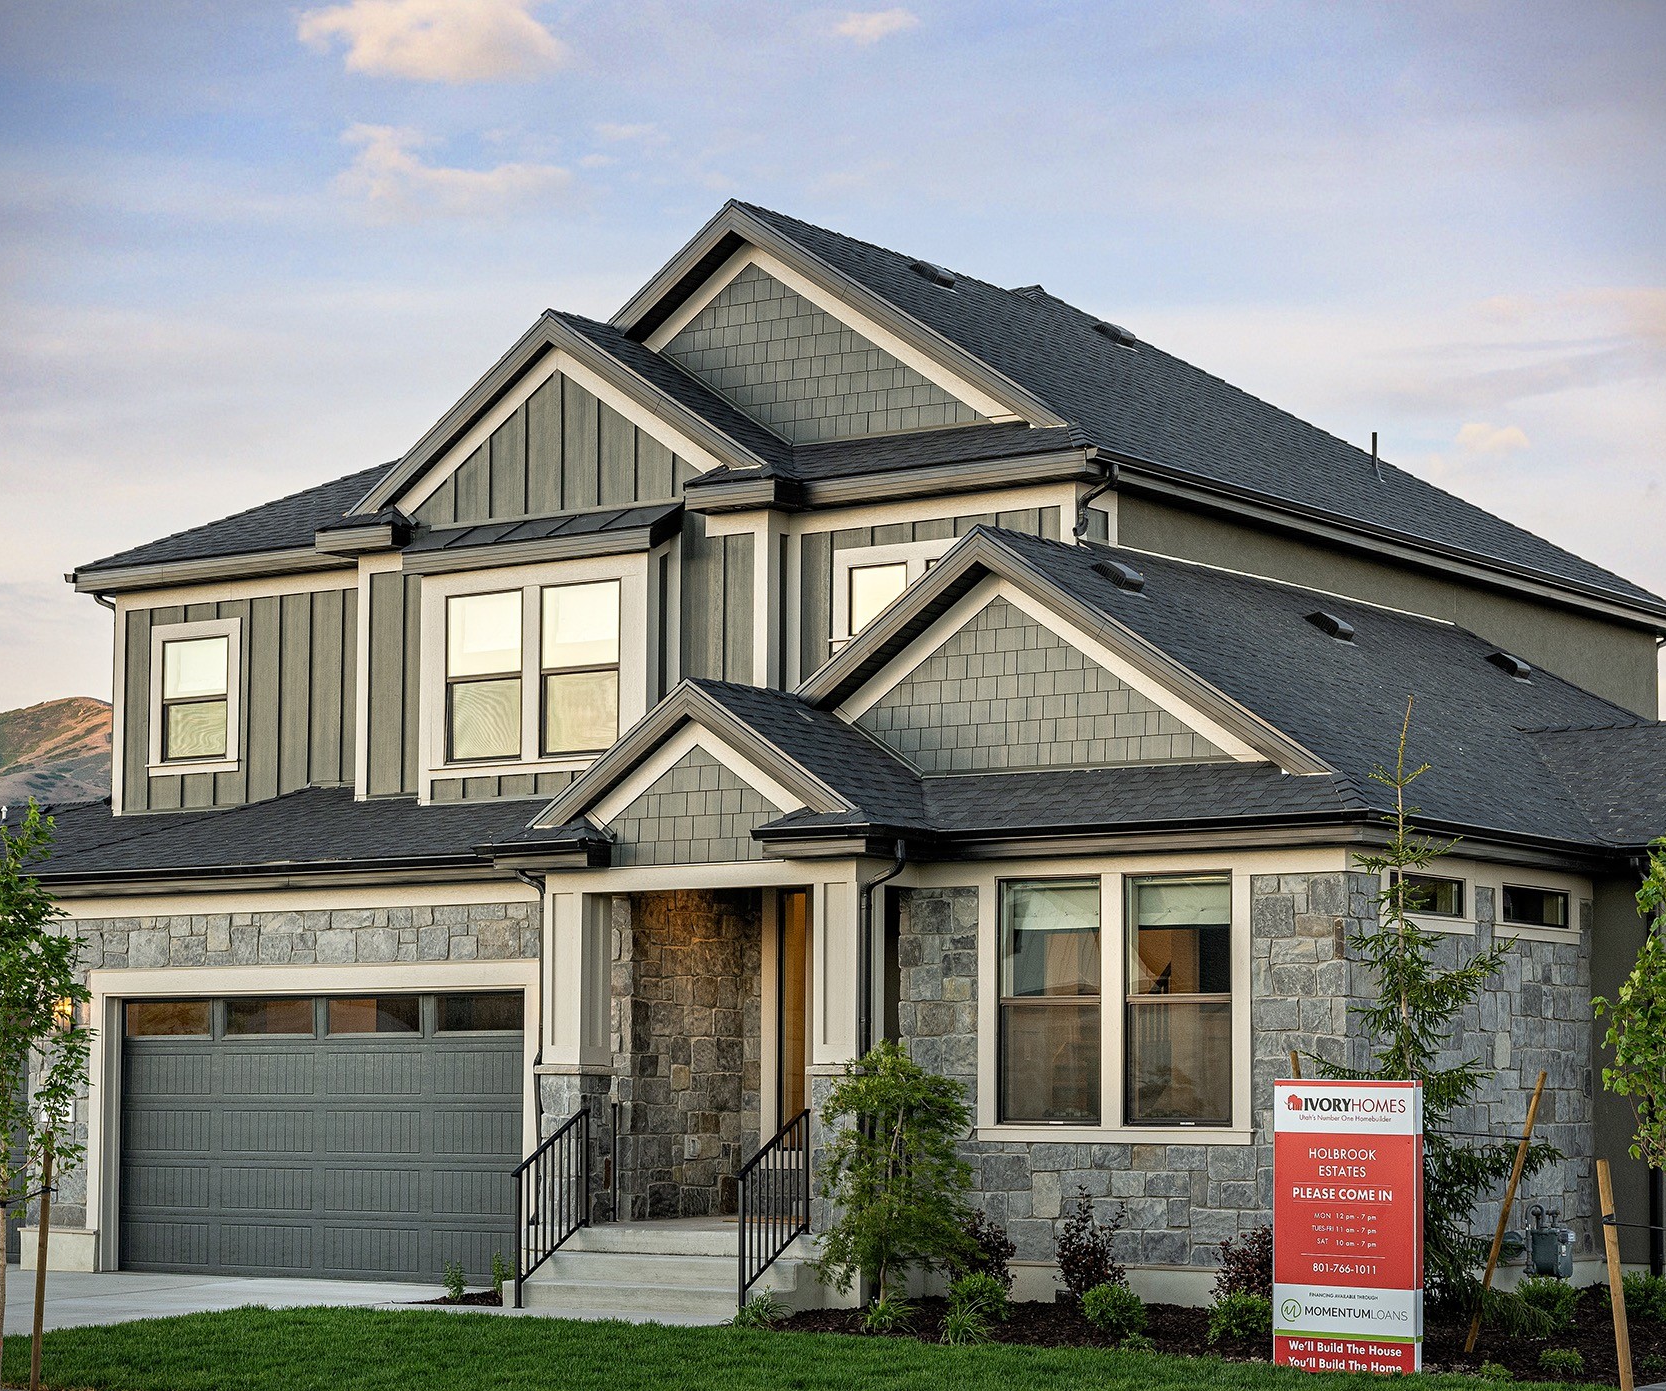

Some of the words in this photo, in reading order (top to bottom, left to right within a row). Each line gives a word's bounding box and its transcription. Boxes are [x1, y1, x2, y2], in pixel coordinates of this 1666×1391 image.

[1309, 1148, 1376, 1160] HOLBROOK
[1319, 1166, 1366, 1178] ESTATES
[1293, 1187, 1335, 1199] PLEASE
[1339, 1189, 1375, 1200] COME
[1379, 1190, 1392, 1201] IN
[1313, 1263, 1376, 1274] 801-766-1011
[1289, 1340, 1313, 1351] We'll
[1317, 1343, 1343, 1353] Build
[1347, 1344, 1365, 1354] The
[1369, 1346, 1402, 1357] House
[1289, 1357, 1315, 1367] You'll
[1319, 1359, 1345, 1369] Build
[1349, 1360, 1367, 1371] The
[1371, 1362, 1401, 1372] Home
